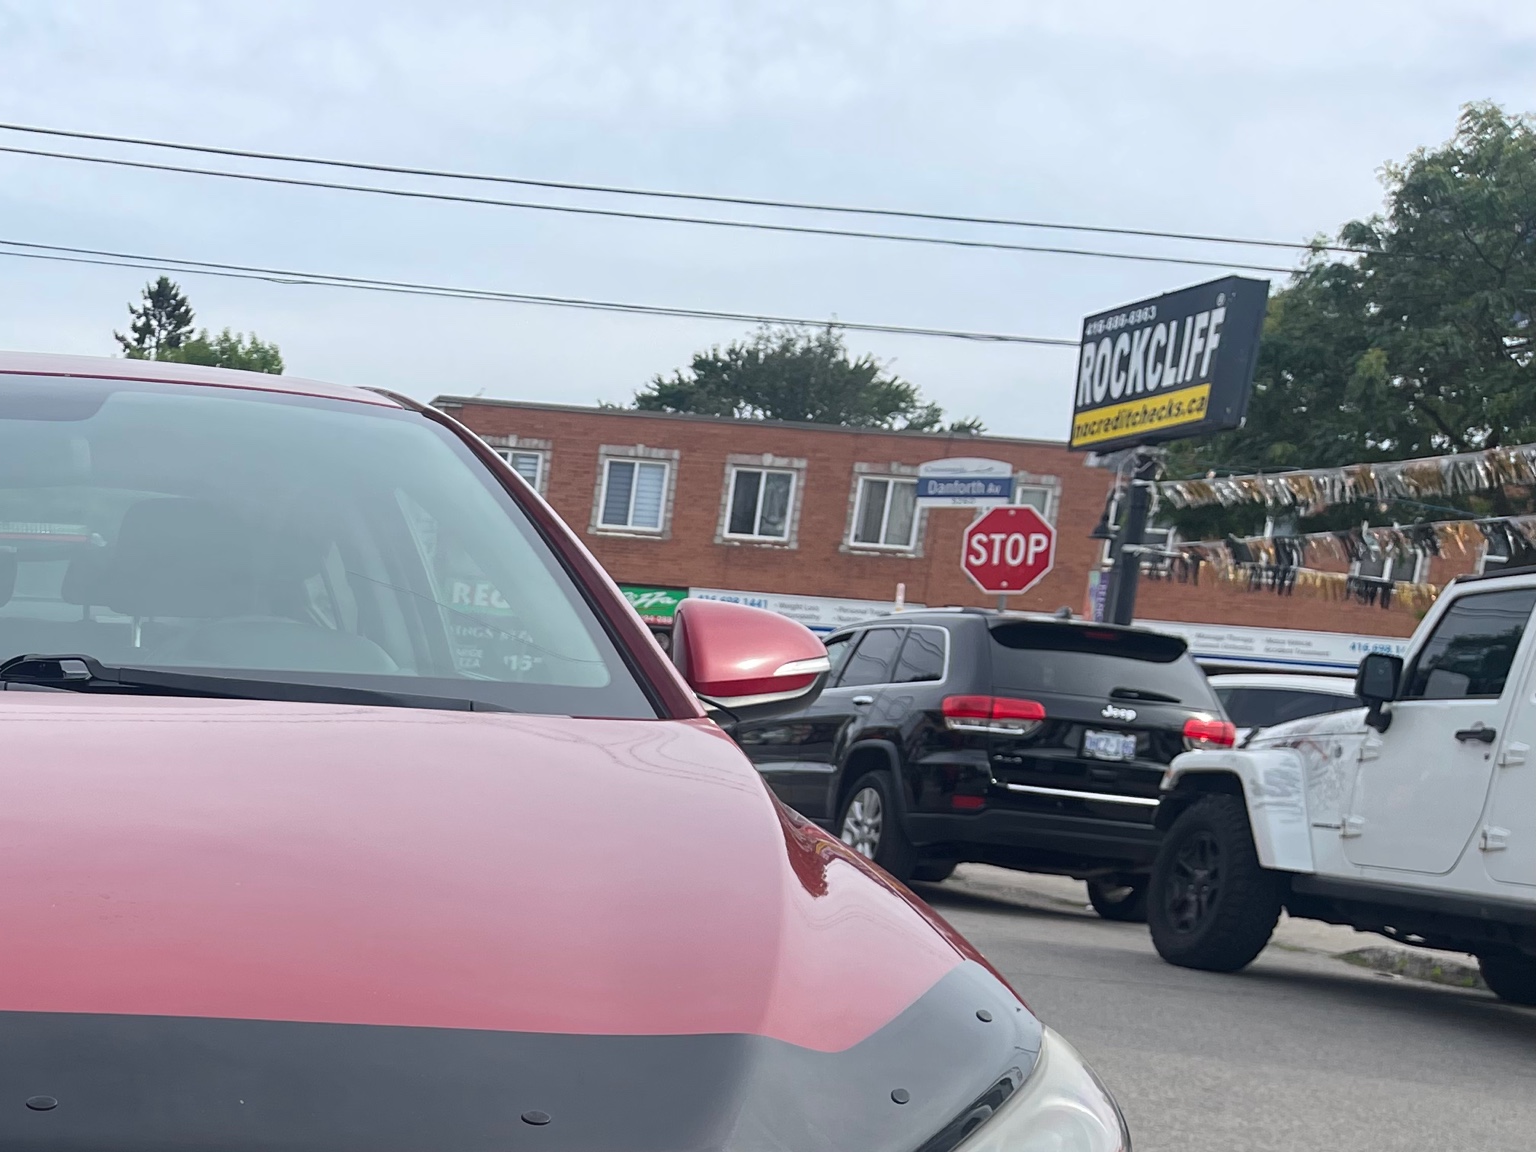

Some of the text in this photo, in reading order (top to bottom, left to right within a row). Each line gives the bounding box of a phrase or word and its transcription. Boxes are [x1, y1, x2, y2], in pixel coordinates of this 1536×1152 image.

[1077, 307, 1226, 407] ROCKCLIFF
[1073, 396, 1206, 439] nocreditchecks.ca
[927, 480, 986, 495] Danforth
[968, 532, 1049, 567] STOP
[1101, 705, 1137, 722] Jeep
